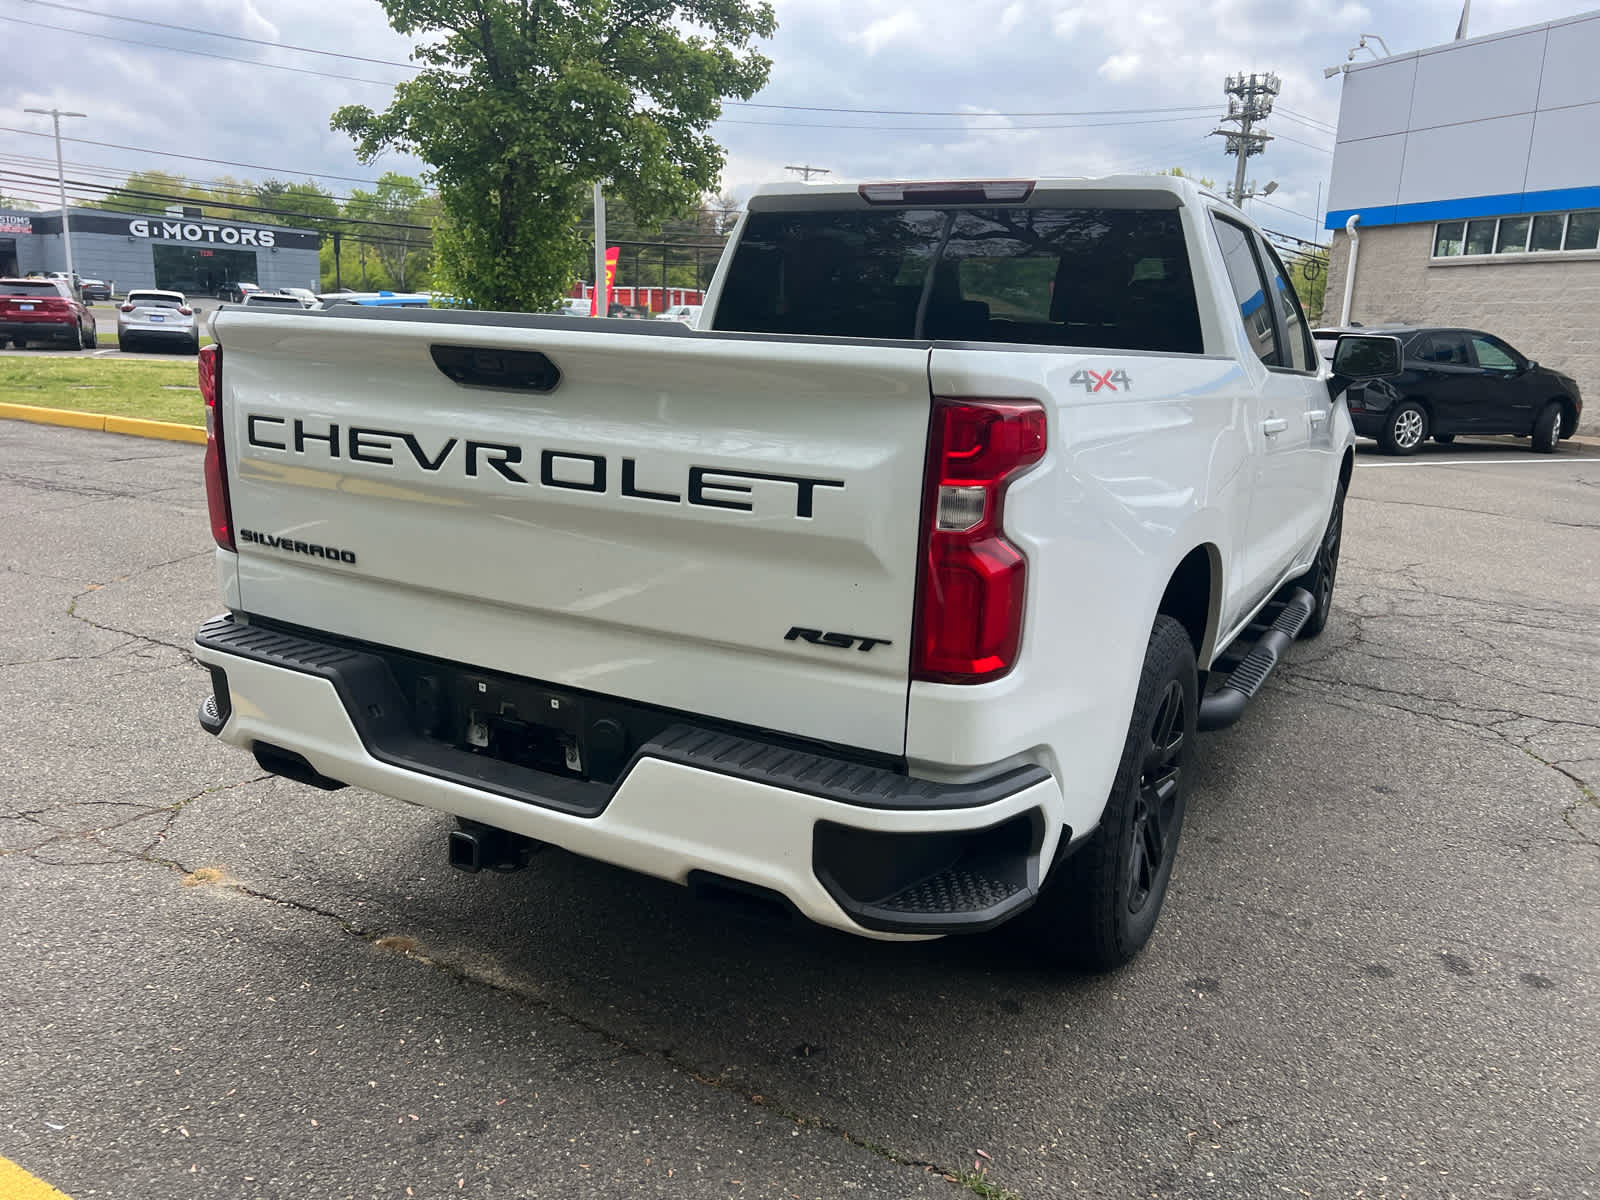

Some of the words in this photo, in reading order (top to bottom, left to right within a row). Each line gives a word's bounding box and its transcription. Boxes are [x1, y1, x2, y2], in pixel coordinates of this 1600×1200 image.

[247, 413, 845, 518] CHEVROLET
[240, 529, 356, 564] SILVERADO
[784, 626, 892, 652] RST
